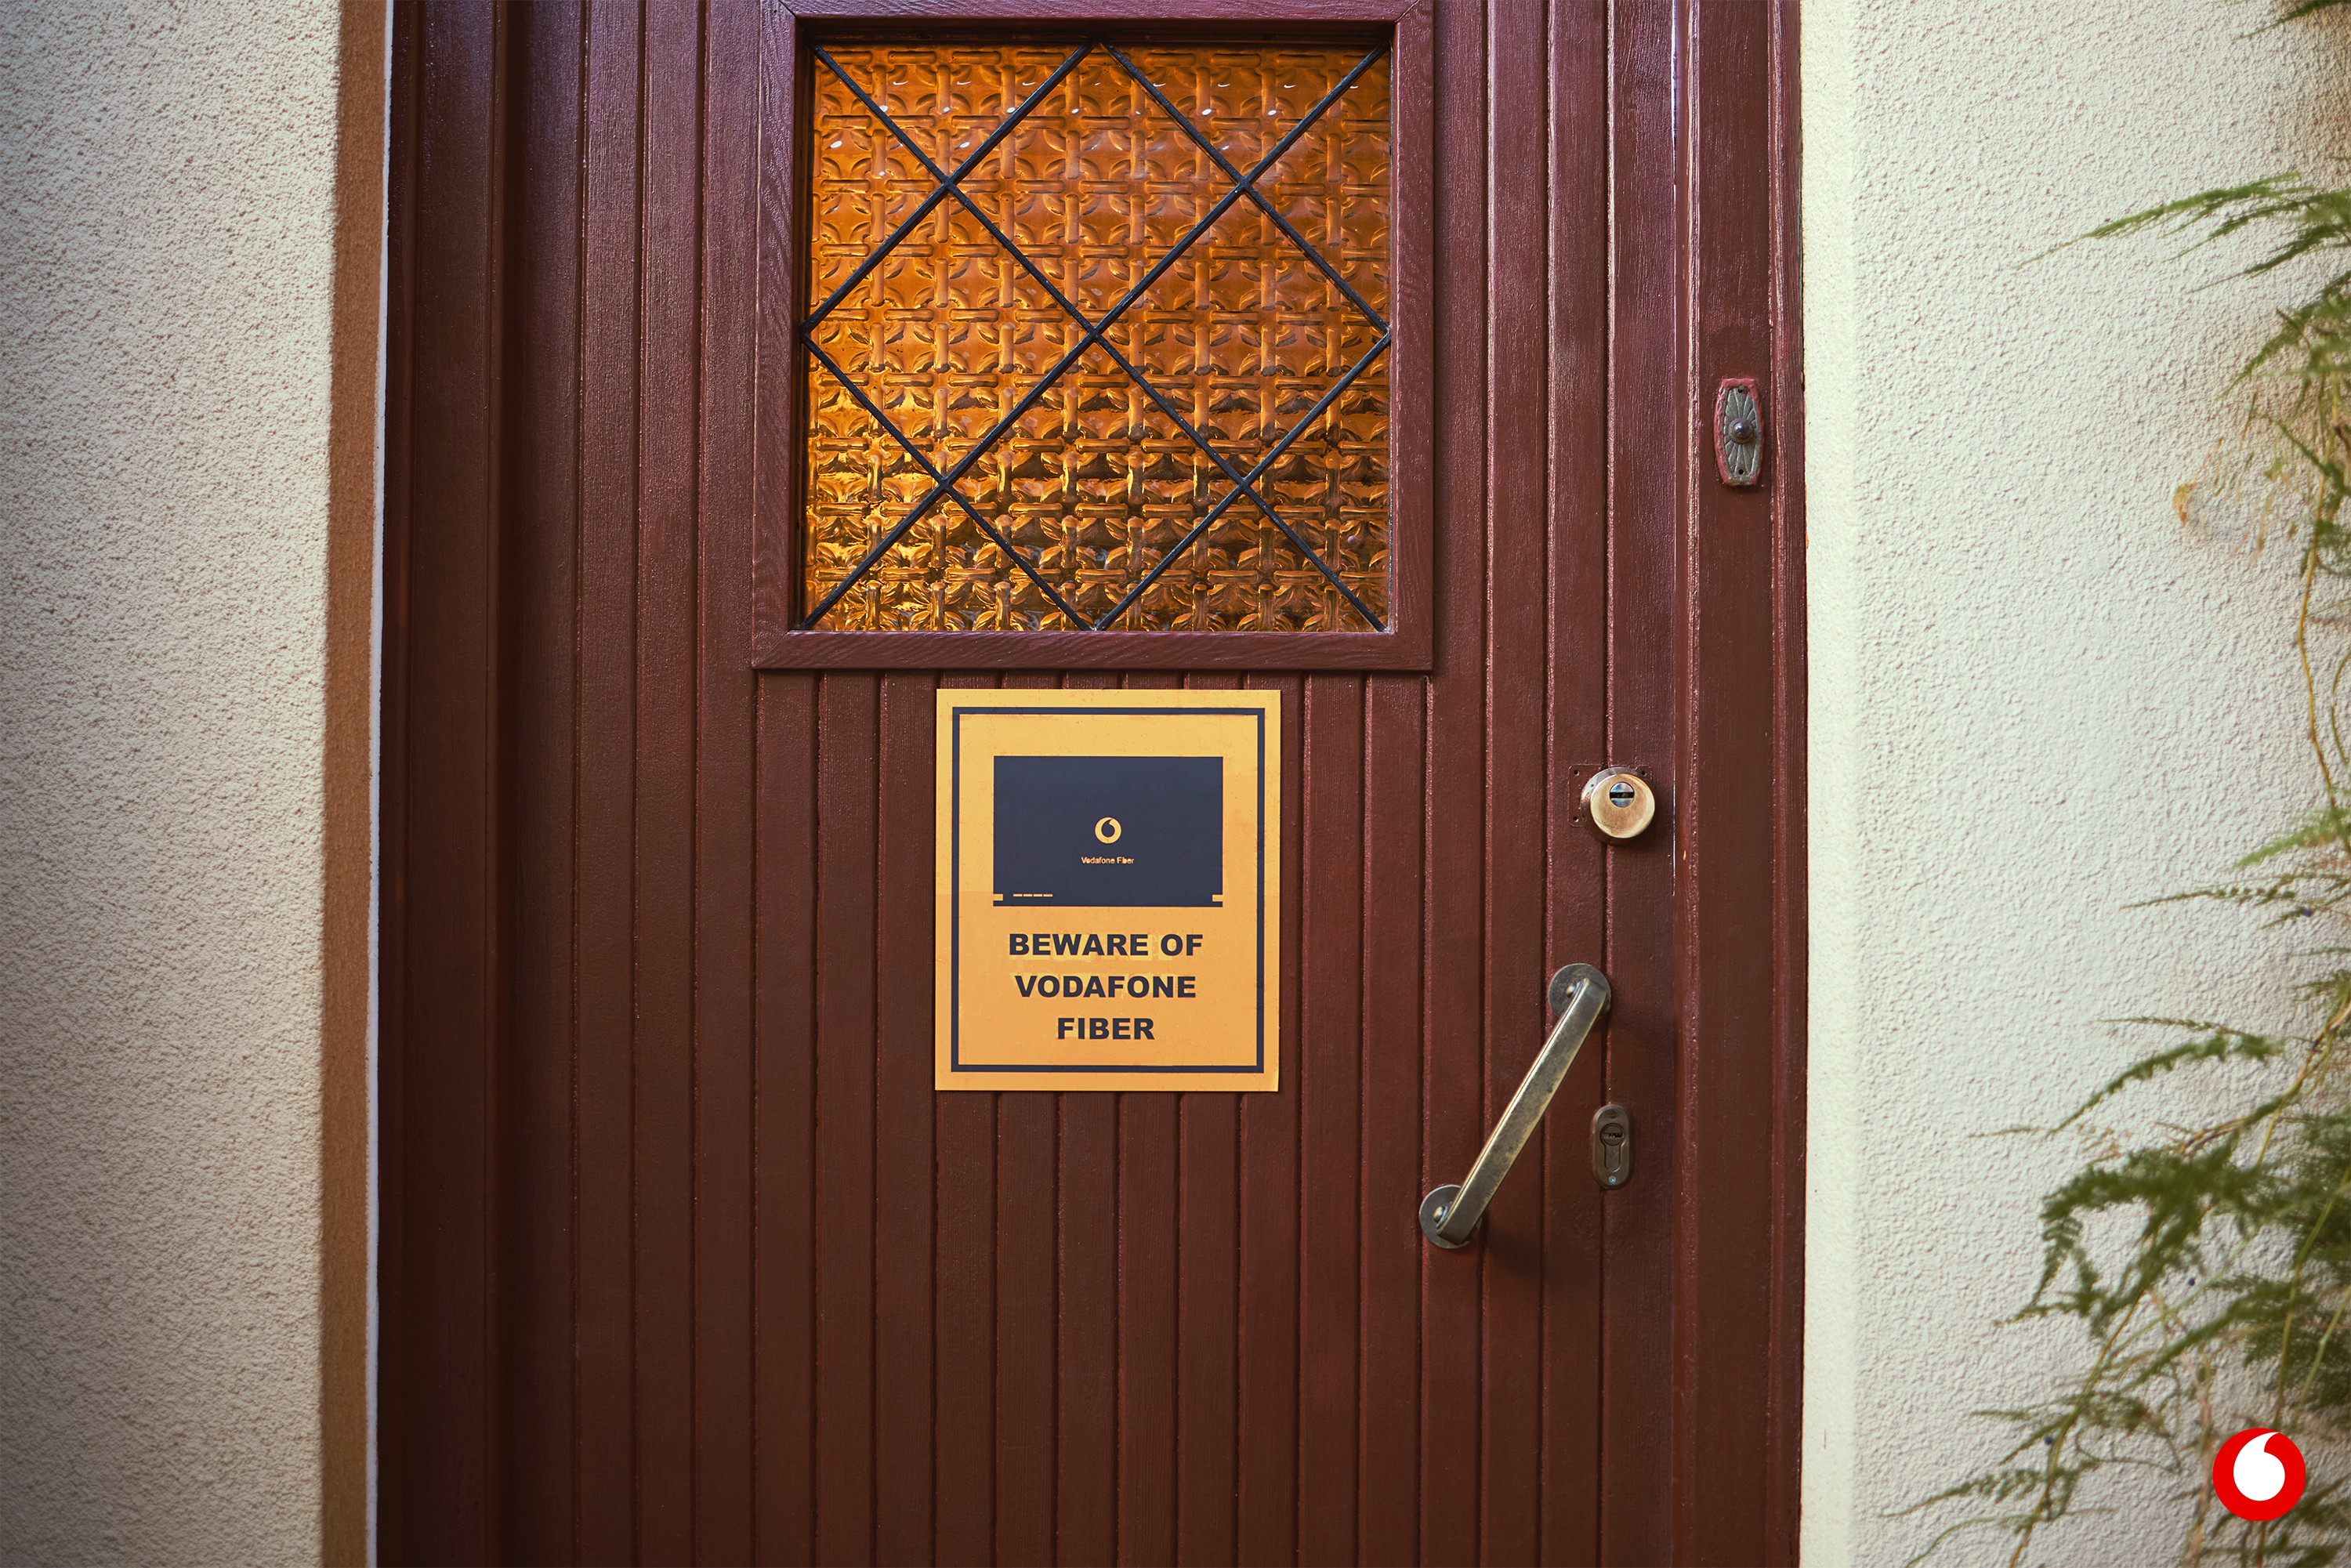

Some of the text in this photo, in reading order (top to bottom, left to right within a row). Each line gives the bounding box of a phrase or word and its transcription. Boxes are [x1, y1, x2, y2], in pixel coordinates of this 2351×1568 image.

[1081, 856, 1115, 864] Vodafone
[1009, 933, 1204, 956] BEWARE OF
[1014, 976, 1196, 998] VODAFONE
[1057, 1018, 1155, 1040] FIBER
